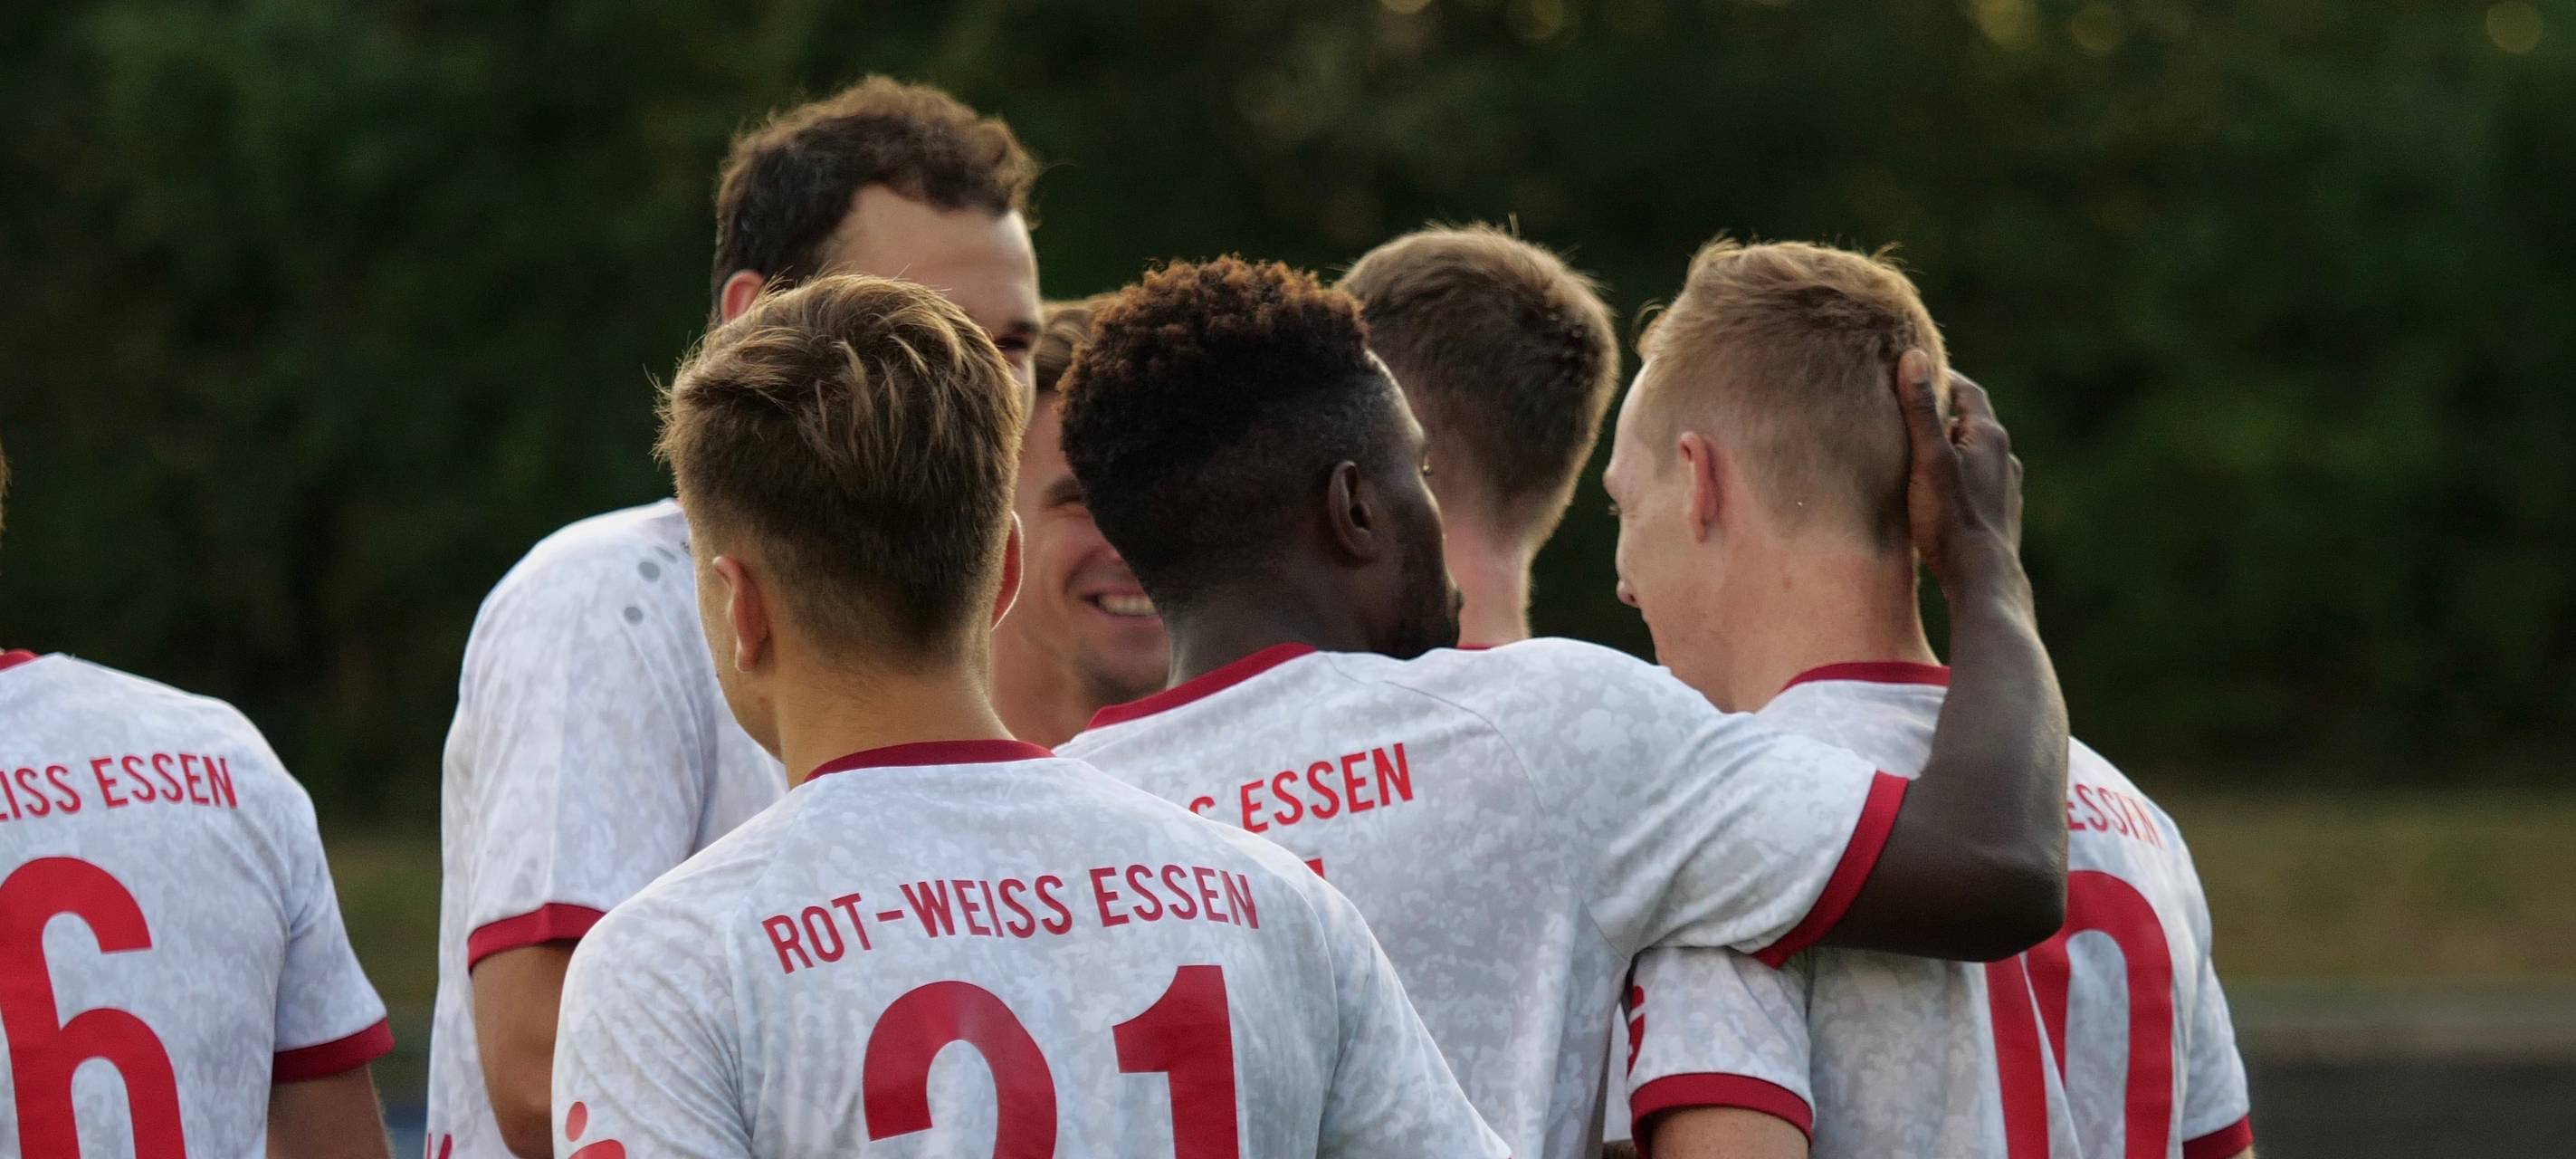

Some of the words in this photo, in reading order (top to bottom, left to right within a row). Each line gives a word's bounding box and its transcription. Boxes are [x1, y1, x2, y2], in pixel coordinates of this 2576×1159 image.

[90, 752, 237, 809] ESSEN
[1240, 742, 1414, 834] ESSEN
[761, 875, 1073, 974] ROT-WEISS
[1089, 863, 1259, 929] ESSEN
